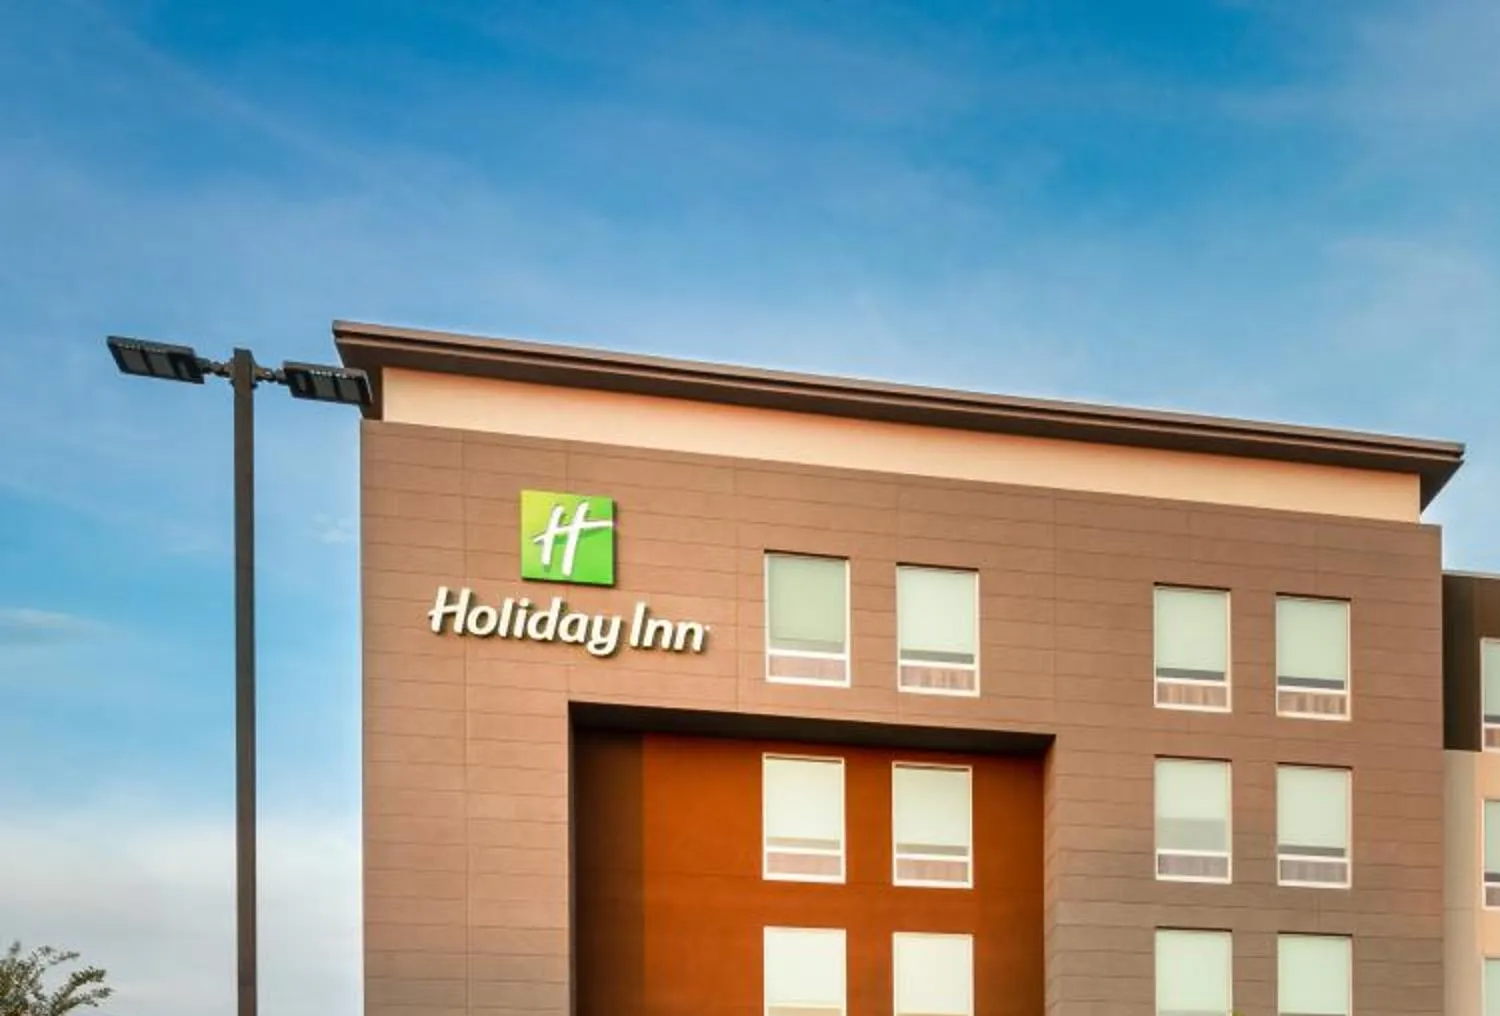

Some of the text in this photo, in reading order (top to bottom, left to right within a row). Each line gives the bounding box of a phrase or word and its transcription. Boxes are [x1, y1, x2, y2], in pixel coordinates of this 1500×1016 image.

[533, 502, 613, 576] H
[428, 586, 704, 656] Holiday Inn
